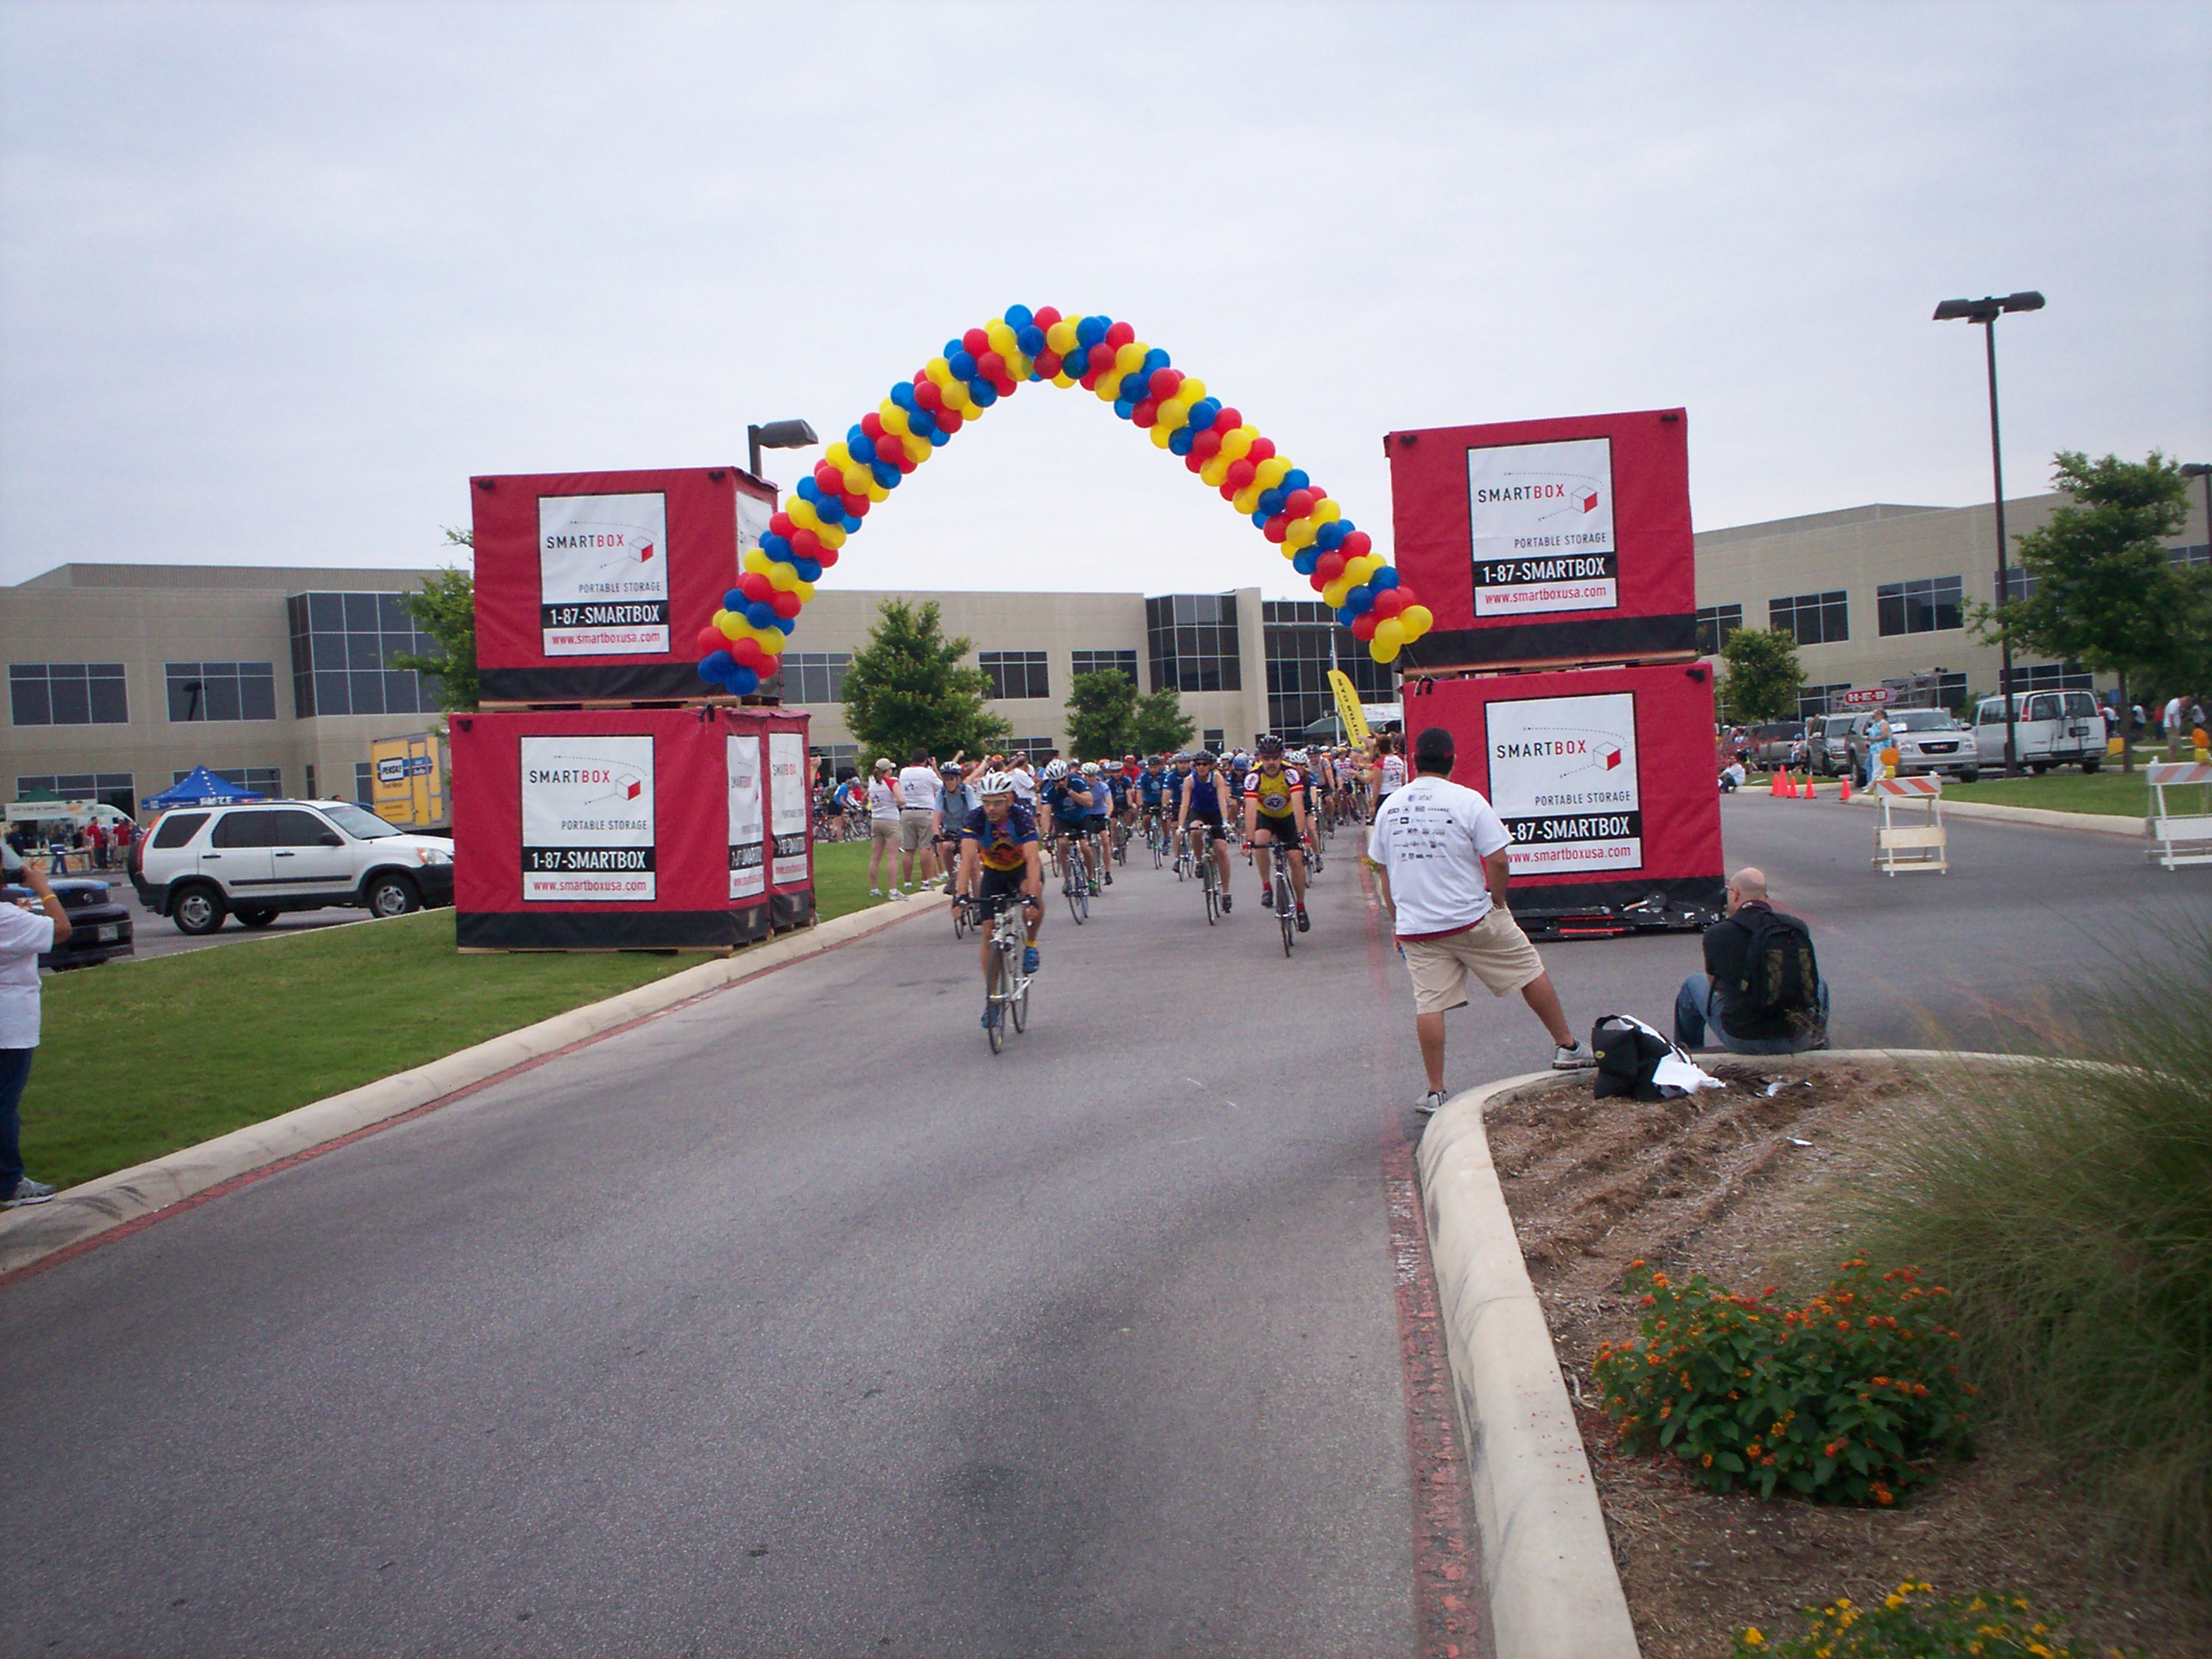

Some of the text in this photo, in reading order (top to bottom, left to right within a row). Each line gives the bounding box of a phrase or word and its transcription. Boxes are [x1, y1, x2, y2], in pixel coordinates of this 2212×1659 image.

[1478, 483, 1565, 503] SMARTBOX
[546, 534, 624, 549] SMARTBOX
[1514, 532, 1607, 549] PORTABLE STORAGE
[1483, 557, 1606, 583] 1-87-SMARTBOX
[579, 581, 660, 593] PORTABLE STORAGE
[1485, 586, 1607, 605] www.smartboxusa.com
[550, 605, 659, 625] 1-87-SMARTBOX
[552, 631, 660, 646] www.smartboxusa.com
[1497, 739, 1587, 759] SMARTBOX
[529, 769, 611, 784] SMARTBOX
[1534, 791, 1631, 806] PORTABLE STORAGE
[561, 820, 647, 830] PORTABLE STORAGE
[532, 851, 647, 870] 1-87-SMARTBOX
[533, 878, 647, 891] www.smartboxusa.com
